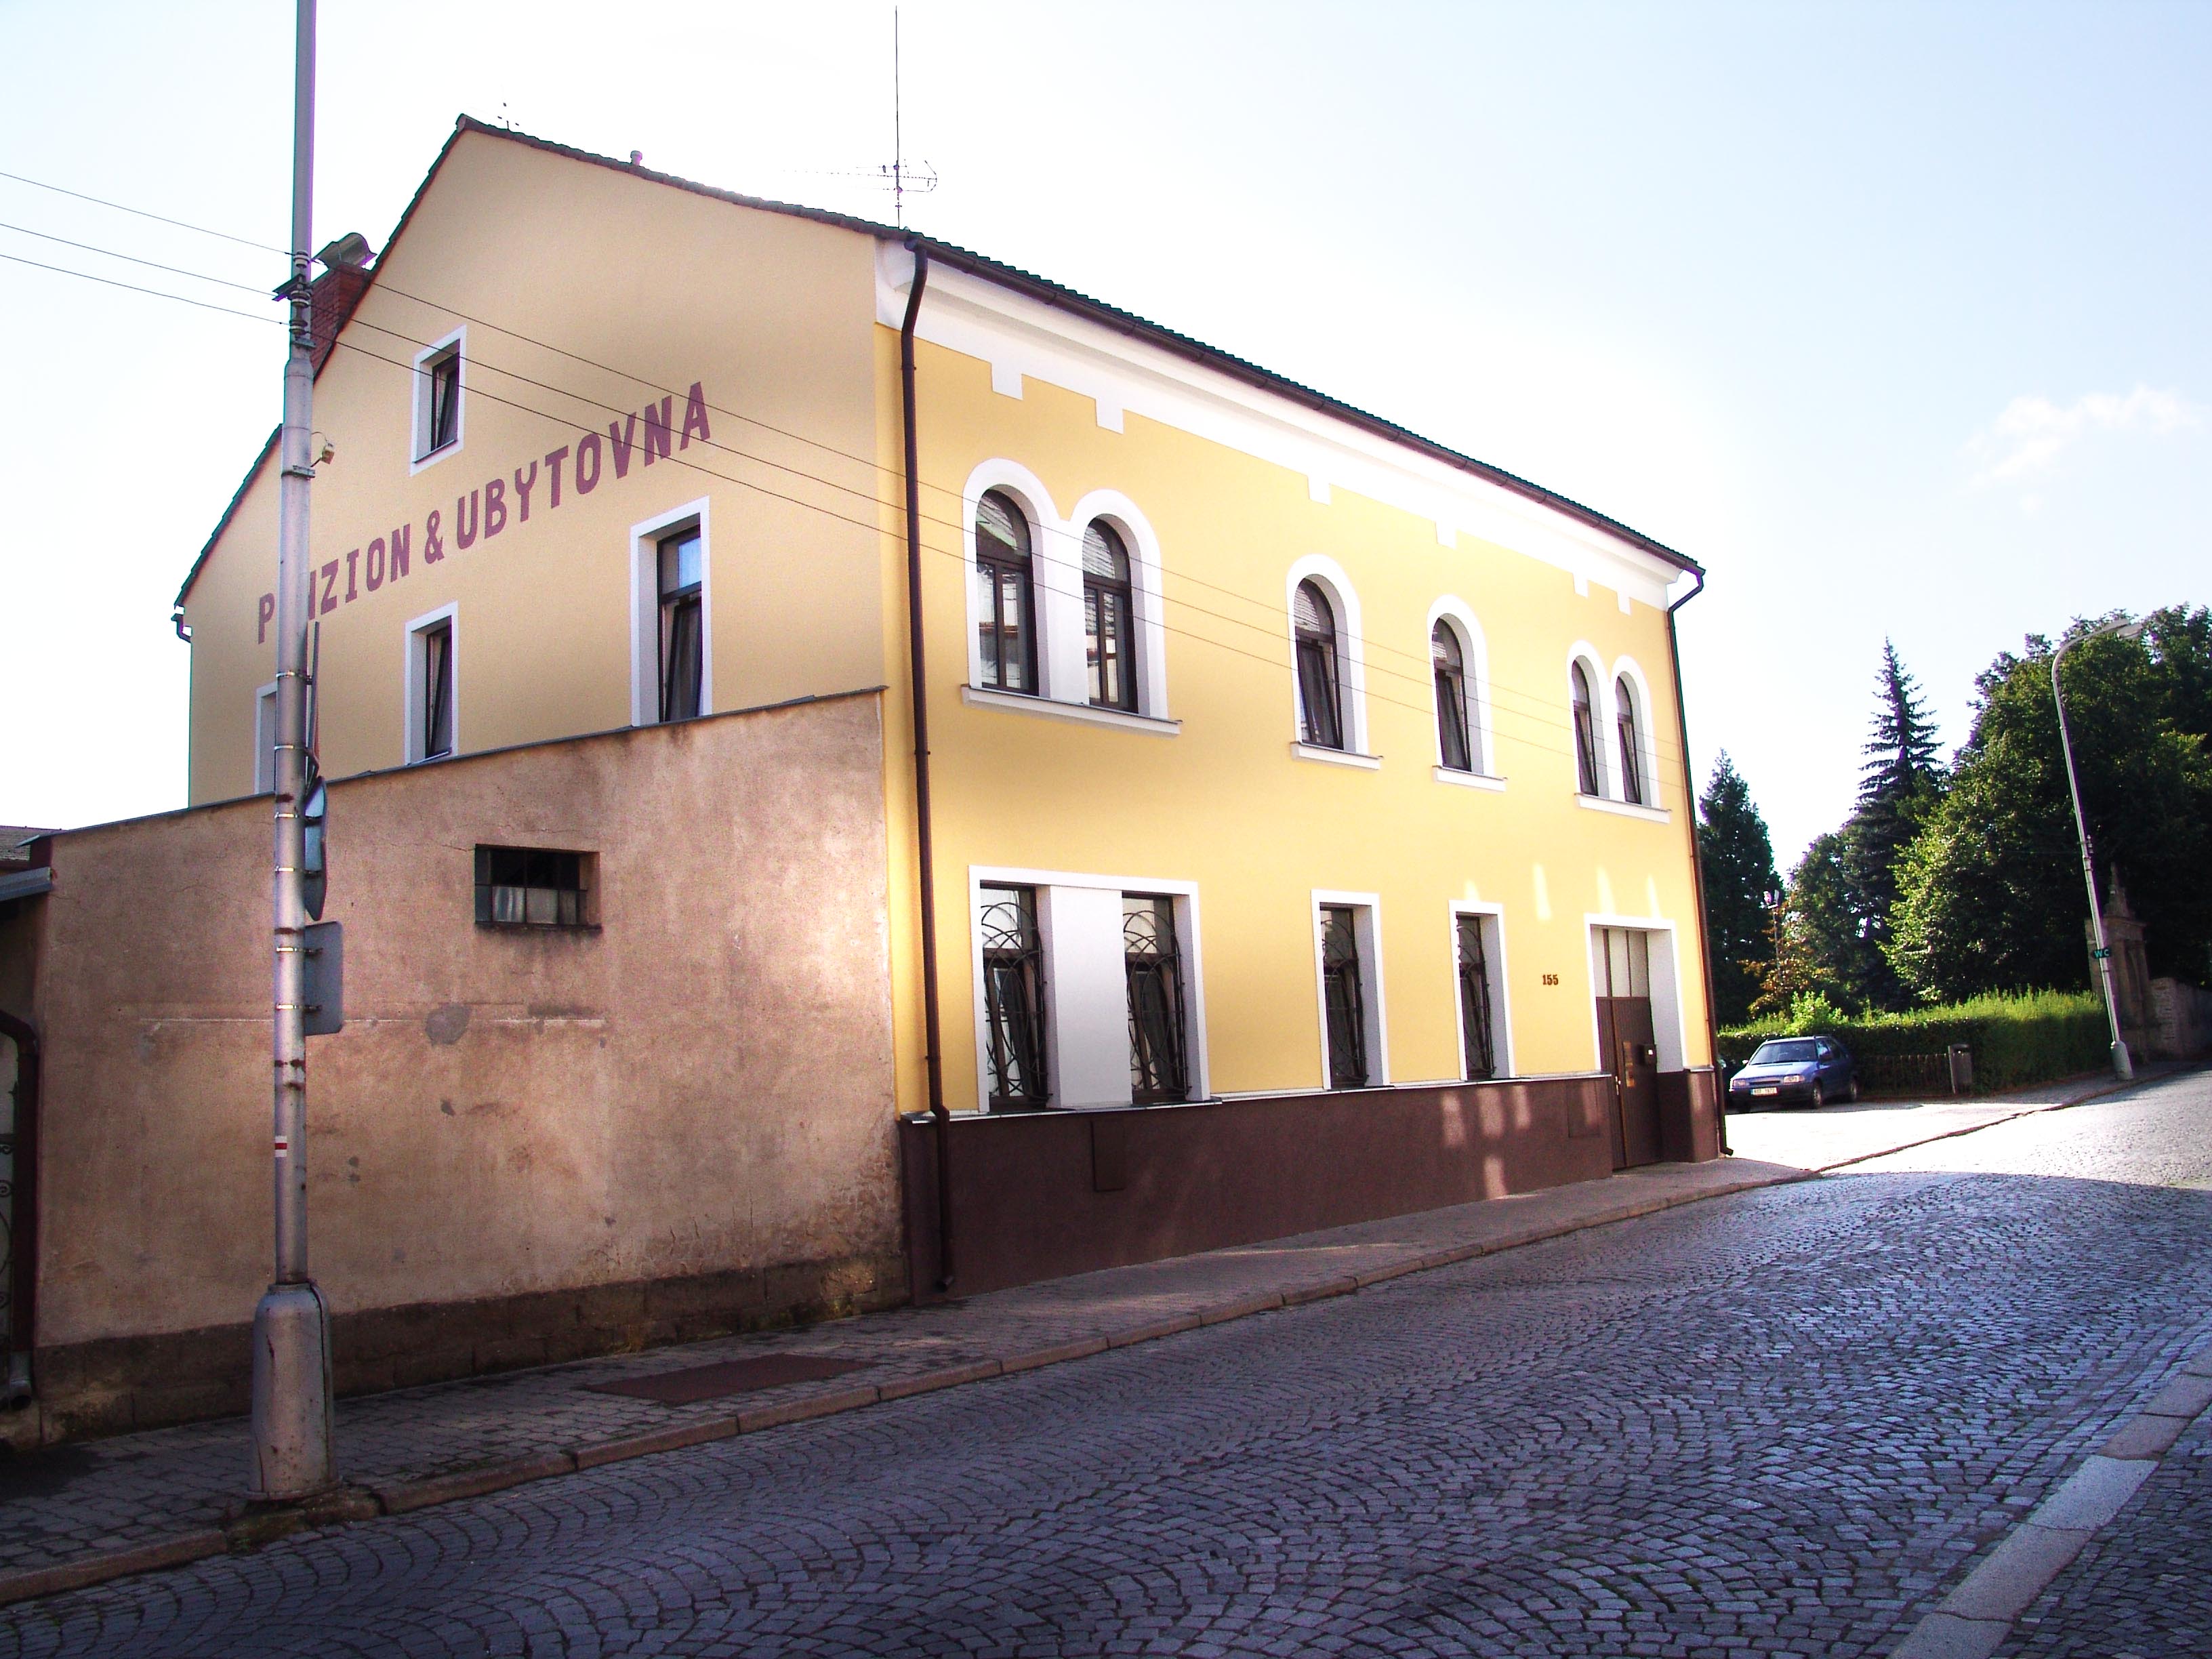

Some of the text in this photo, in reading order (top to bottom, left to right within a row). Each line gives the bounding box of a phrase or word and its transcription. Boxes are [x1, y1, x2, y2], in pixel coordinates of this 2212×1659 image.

[258, 381, 711, 645] PZION & UBYTOVNA
[2094, 949, 2110, 958] WC
[1542, 974, 1559, 985] 155
